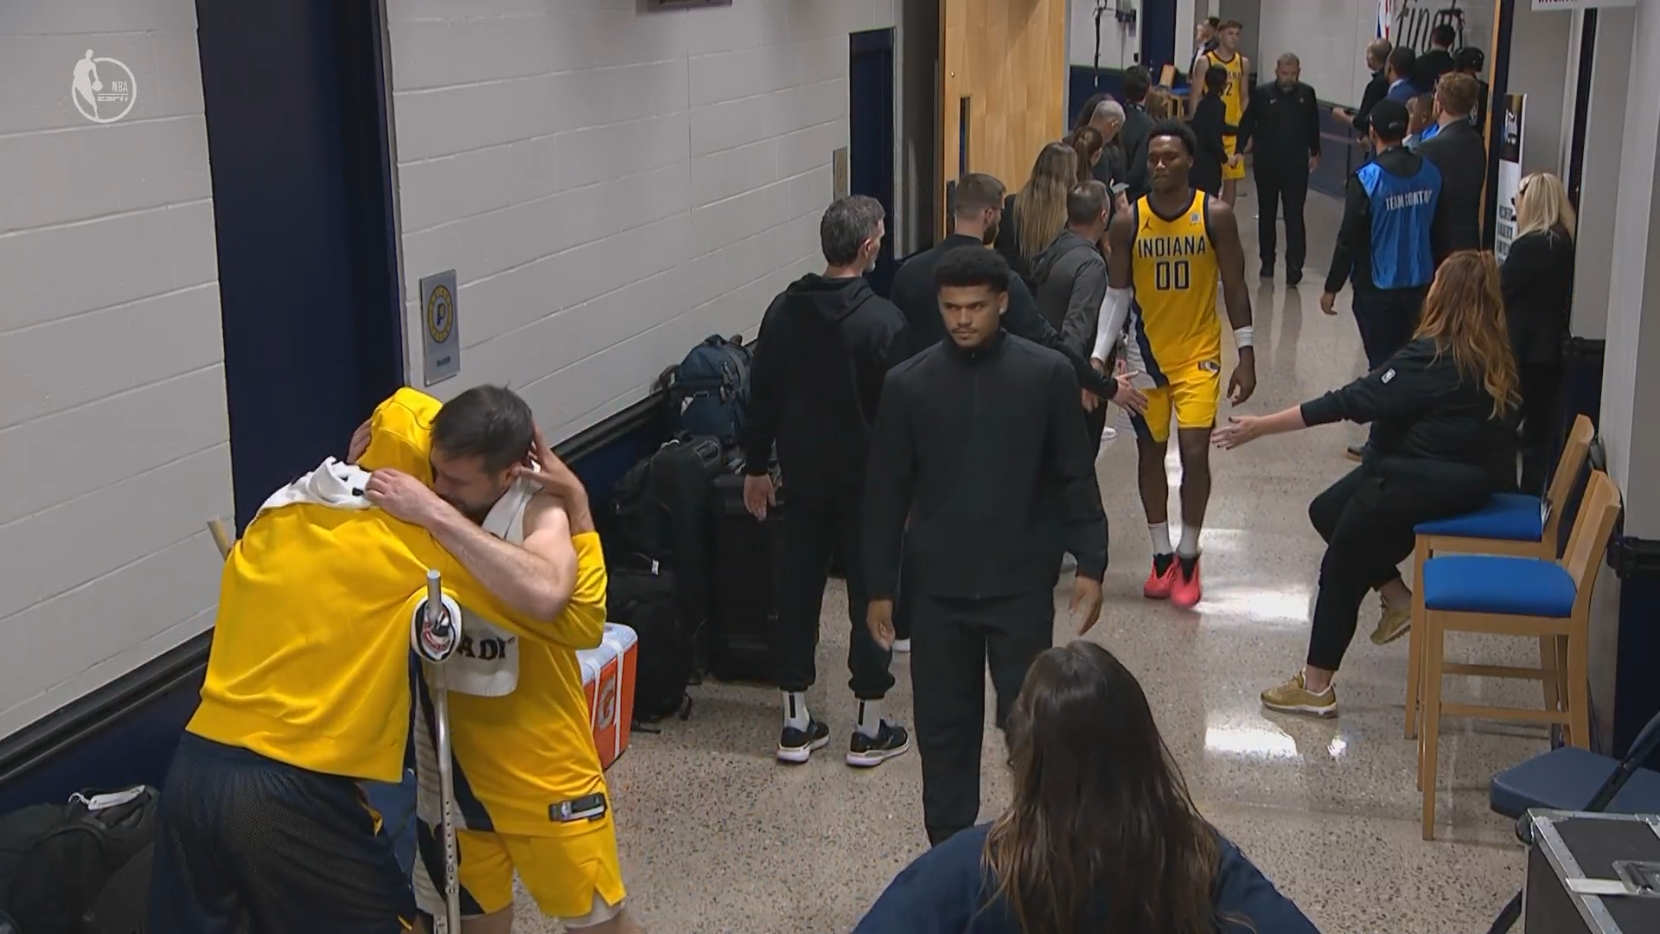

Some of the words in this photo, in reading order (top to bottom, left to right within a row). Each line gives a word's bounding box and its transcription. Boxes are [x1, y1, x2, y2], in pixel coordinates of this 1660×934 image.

[1385, 194, 1405, 210] TEAM
[1138, 235, 1206, 258] INDIANA
[1155, 260, 1190, 291] 00
